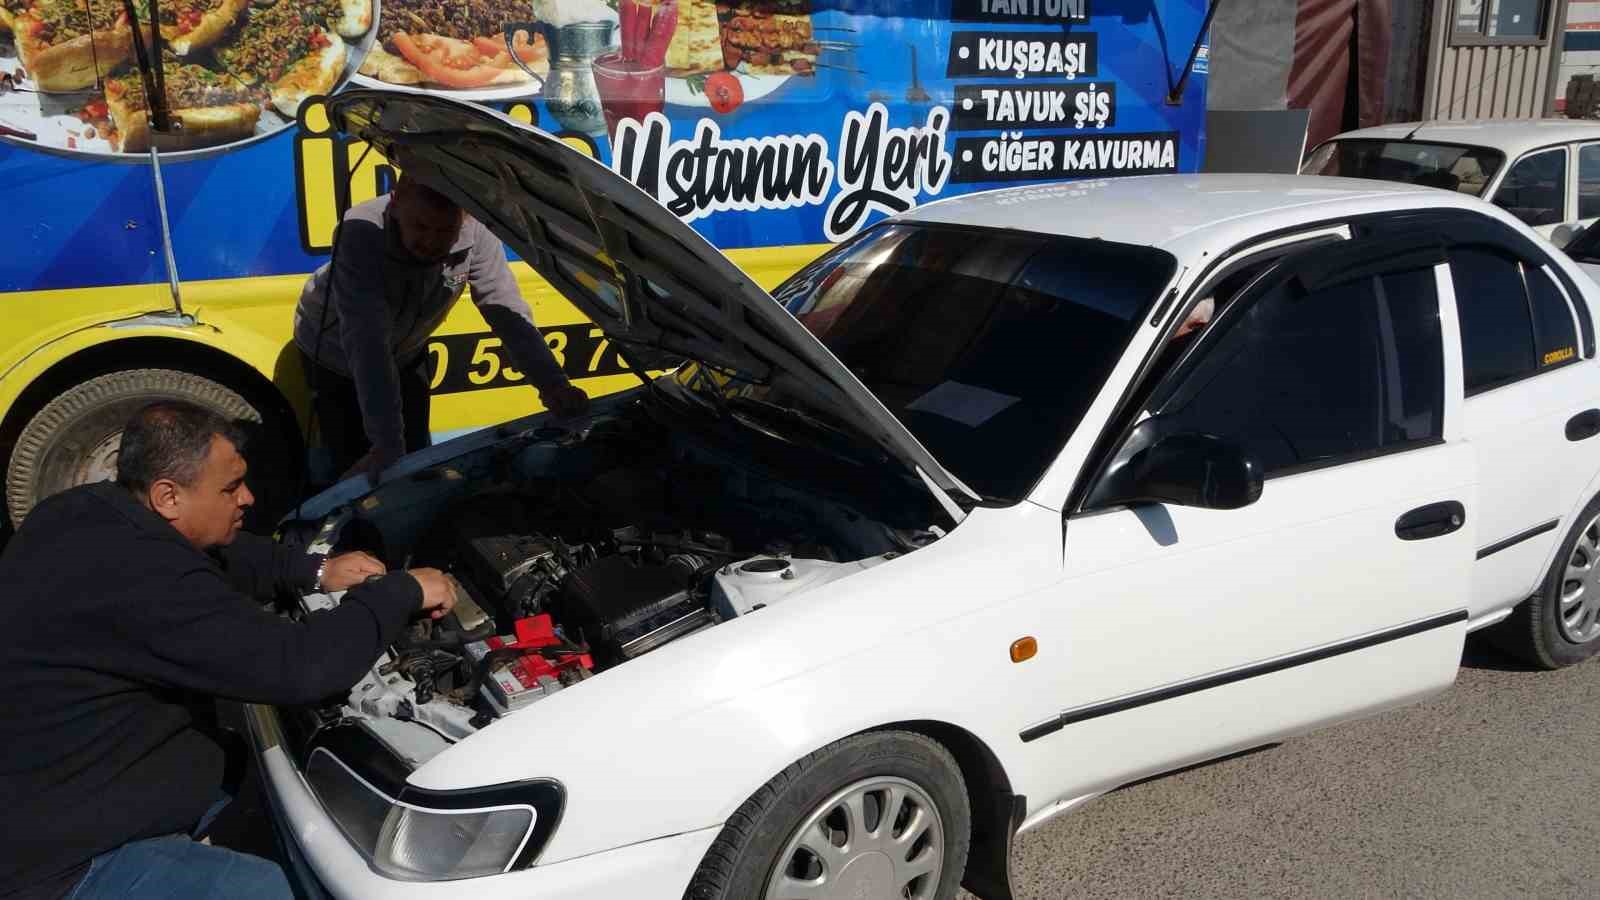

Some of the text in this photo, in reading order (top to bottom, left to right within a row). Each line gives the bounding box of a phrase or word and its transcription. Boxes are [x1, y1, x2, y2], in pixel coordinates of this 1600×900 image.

[978, 38, 1087, 80] KUŞBAŞI
[981, 83, 1110, 130] TAVUK ŞİŞ
[828, 105, 949, 238] Yeri
[982, 131, 1175, 172] CİĞER KAVURMA
